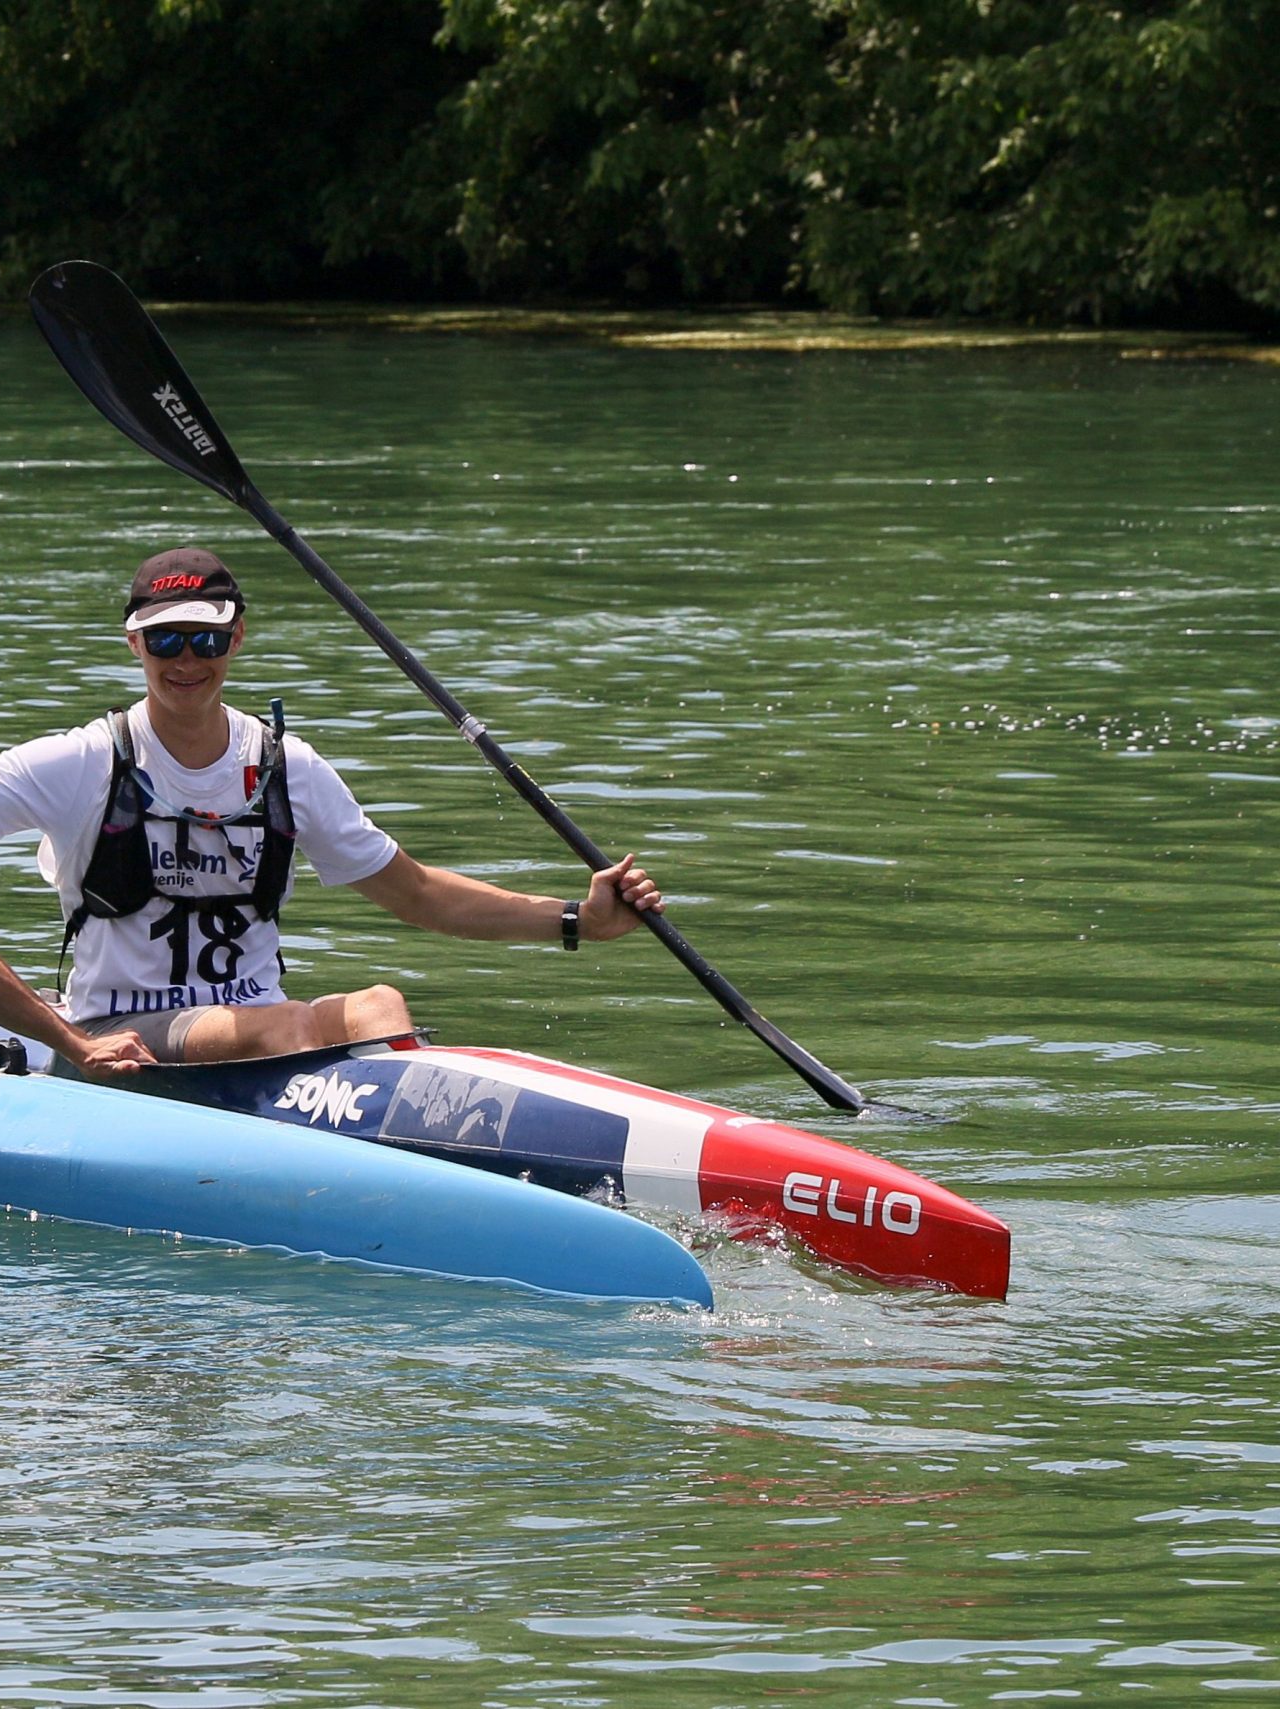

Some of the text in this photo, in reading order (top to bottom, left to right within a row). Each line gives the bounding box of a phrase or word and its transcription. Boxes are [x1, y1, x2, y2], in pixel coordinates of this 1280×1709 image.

[151, 574, 205, 594] TITAN
[150, 902, 251, 985] 18
[273, 1070, 380, 1129] SONIC
[782, 1171, 922, 1236] ELIO
